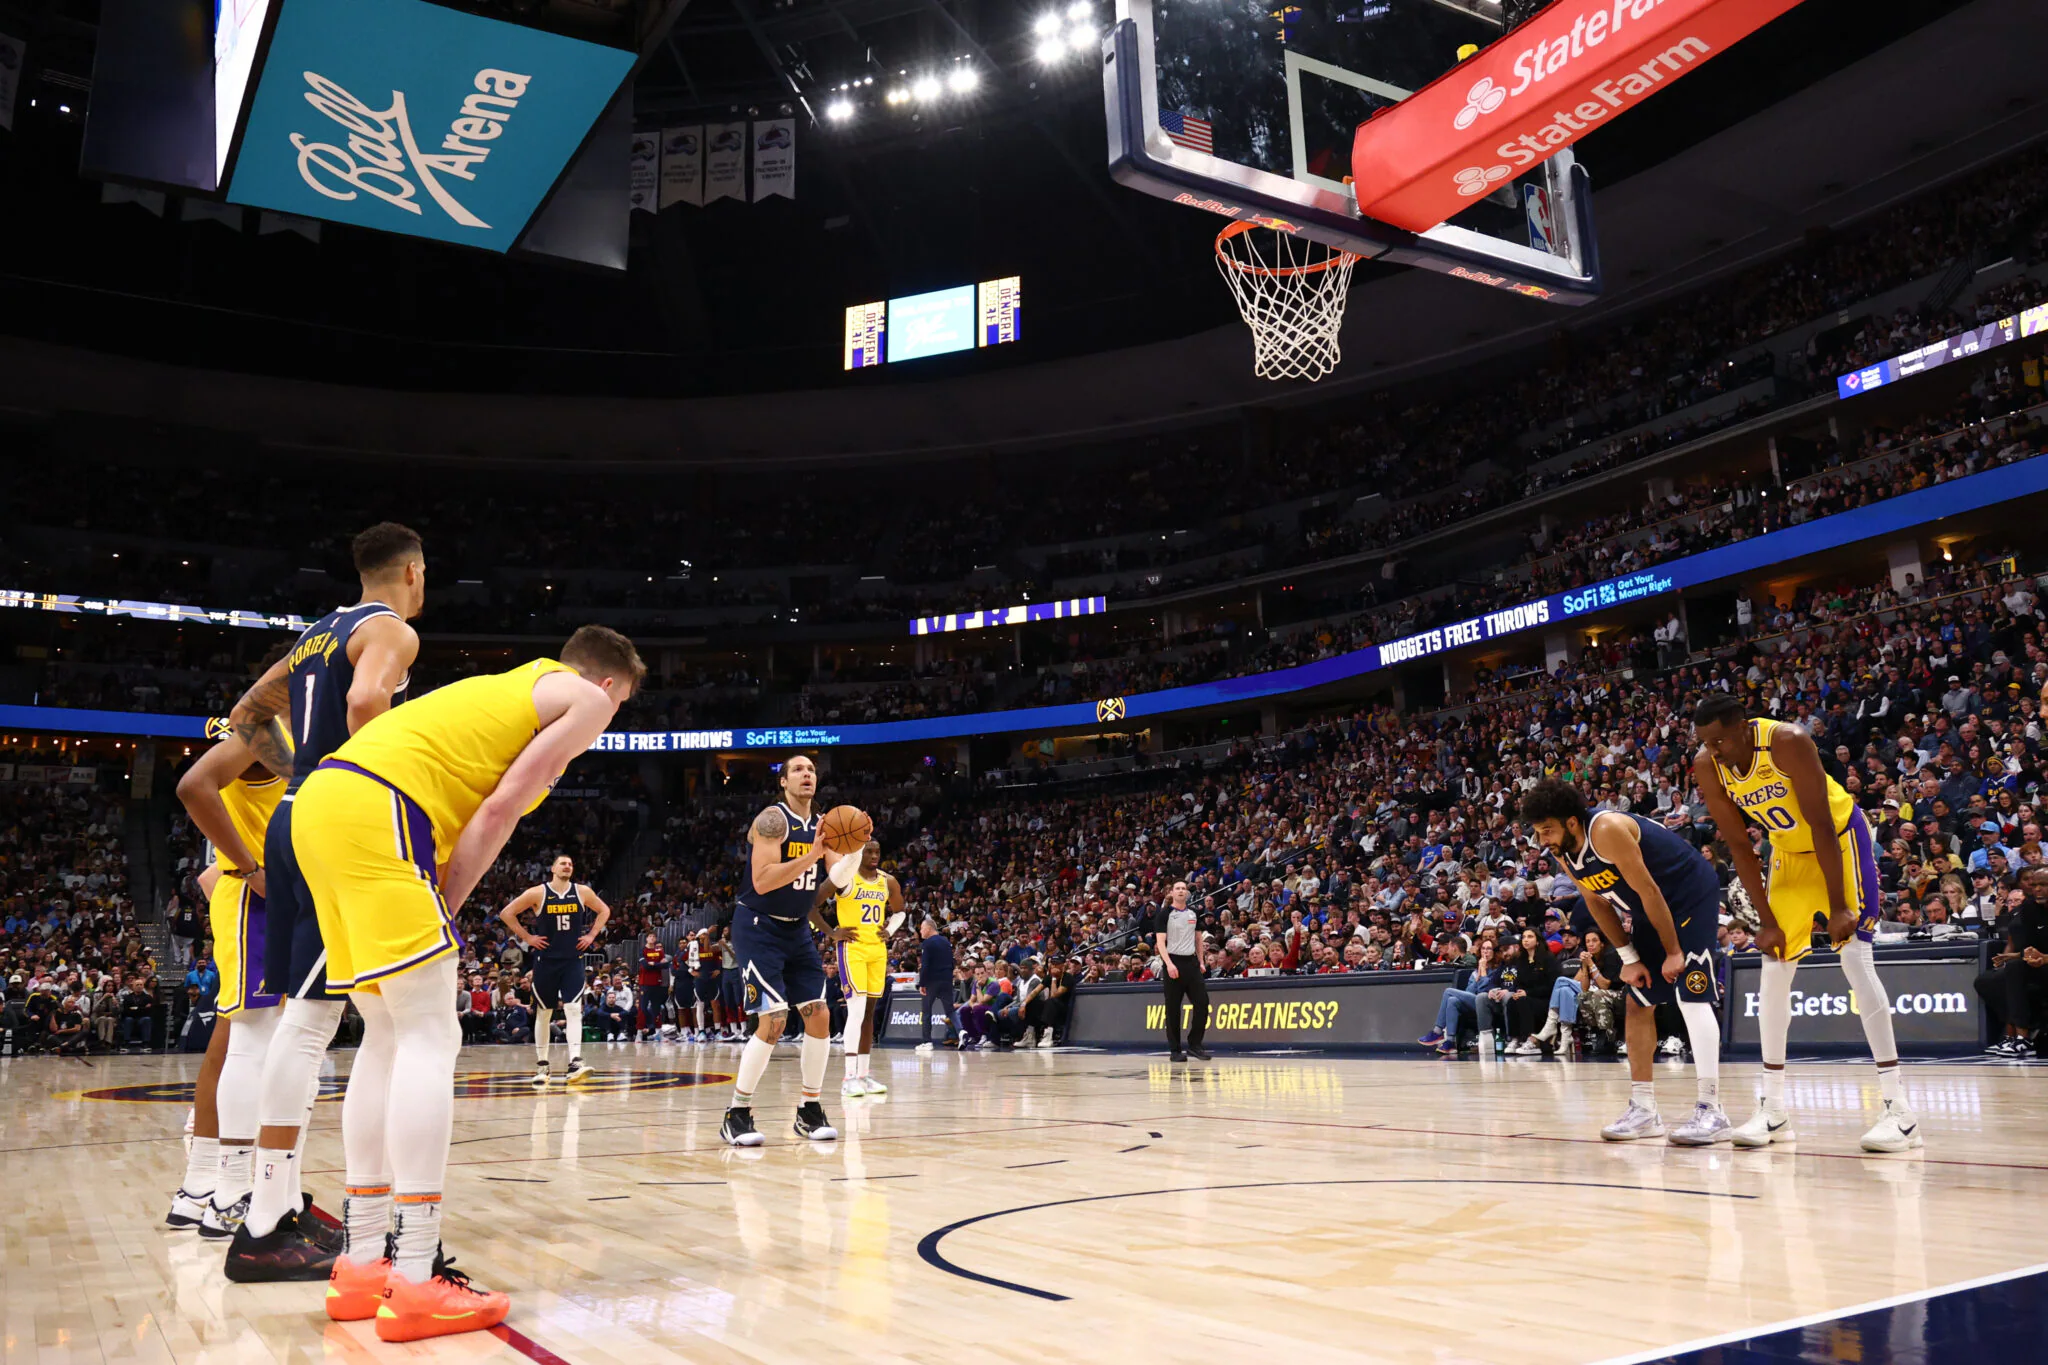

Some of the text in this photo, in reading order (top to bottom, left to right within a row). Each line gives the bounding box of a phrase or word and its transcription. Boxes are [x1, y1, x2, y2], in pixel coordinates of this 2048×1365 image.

[416, 67, 533, 182] Arena
[289, 71, 470, 224] Ball
[2005, 329, 2013, 341] 5
[1617, 574, 1654, 590] Get Your
[1619, 577, 1672, 600] Money Right
[1378, 588, 1598, 666] NUGGETS FREE THROWS SoFi
[302, 673, 316, 745] 1
[629, 733, 666, 750] FREE
[671, 731, 733, 749] THROWS
[746, 731, 777, 746] SoFi
[1752, 806, 1796, 831] 10
[854, 888, 885, 902] LAKERS
[547, 903, 578, 914] DENVER
[861, 904, 881, 923] 20
[556, 915, 570, 931] 15
[1146, 1004, 1194, 1029] WHT
[1215, 1000, 1338, 1030] GREATNESS?
